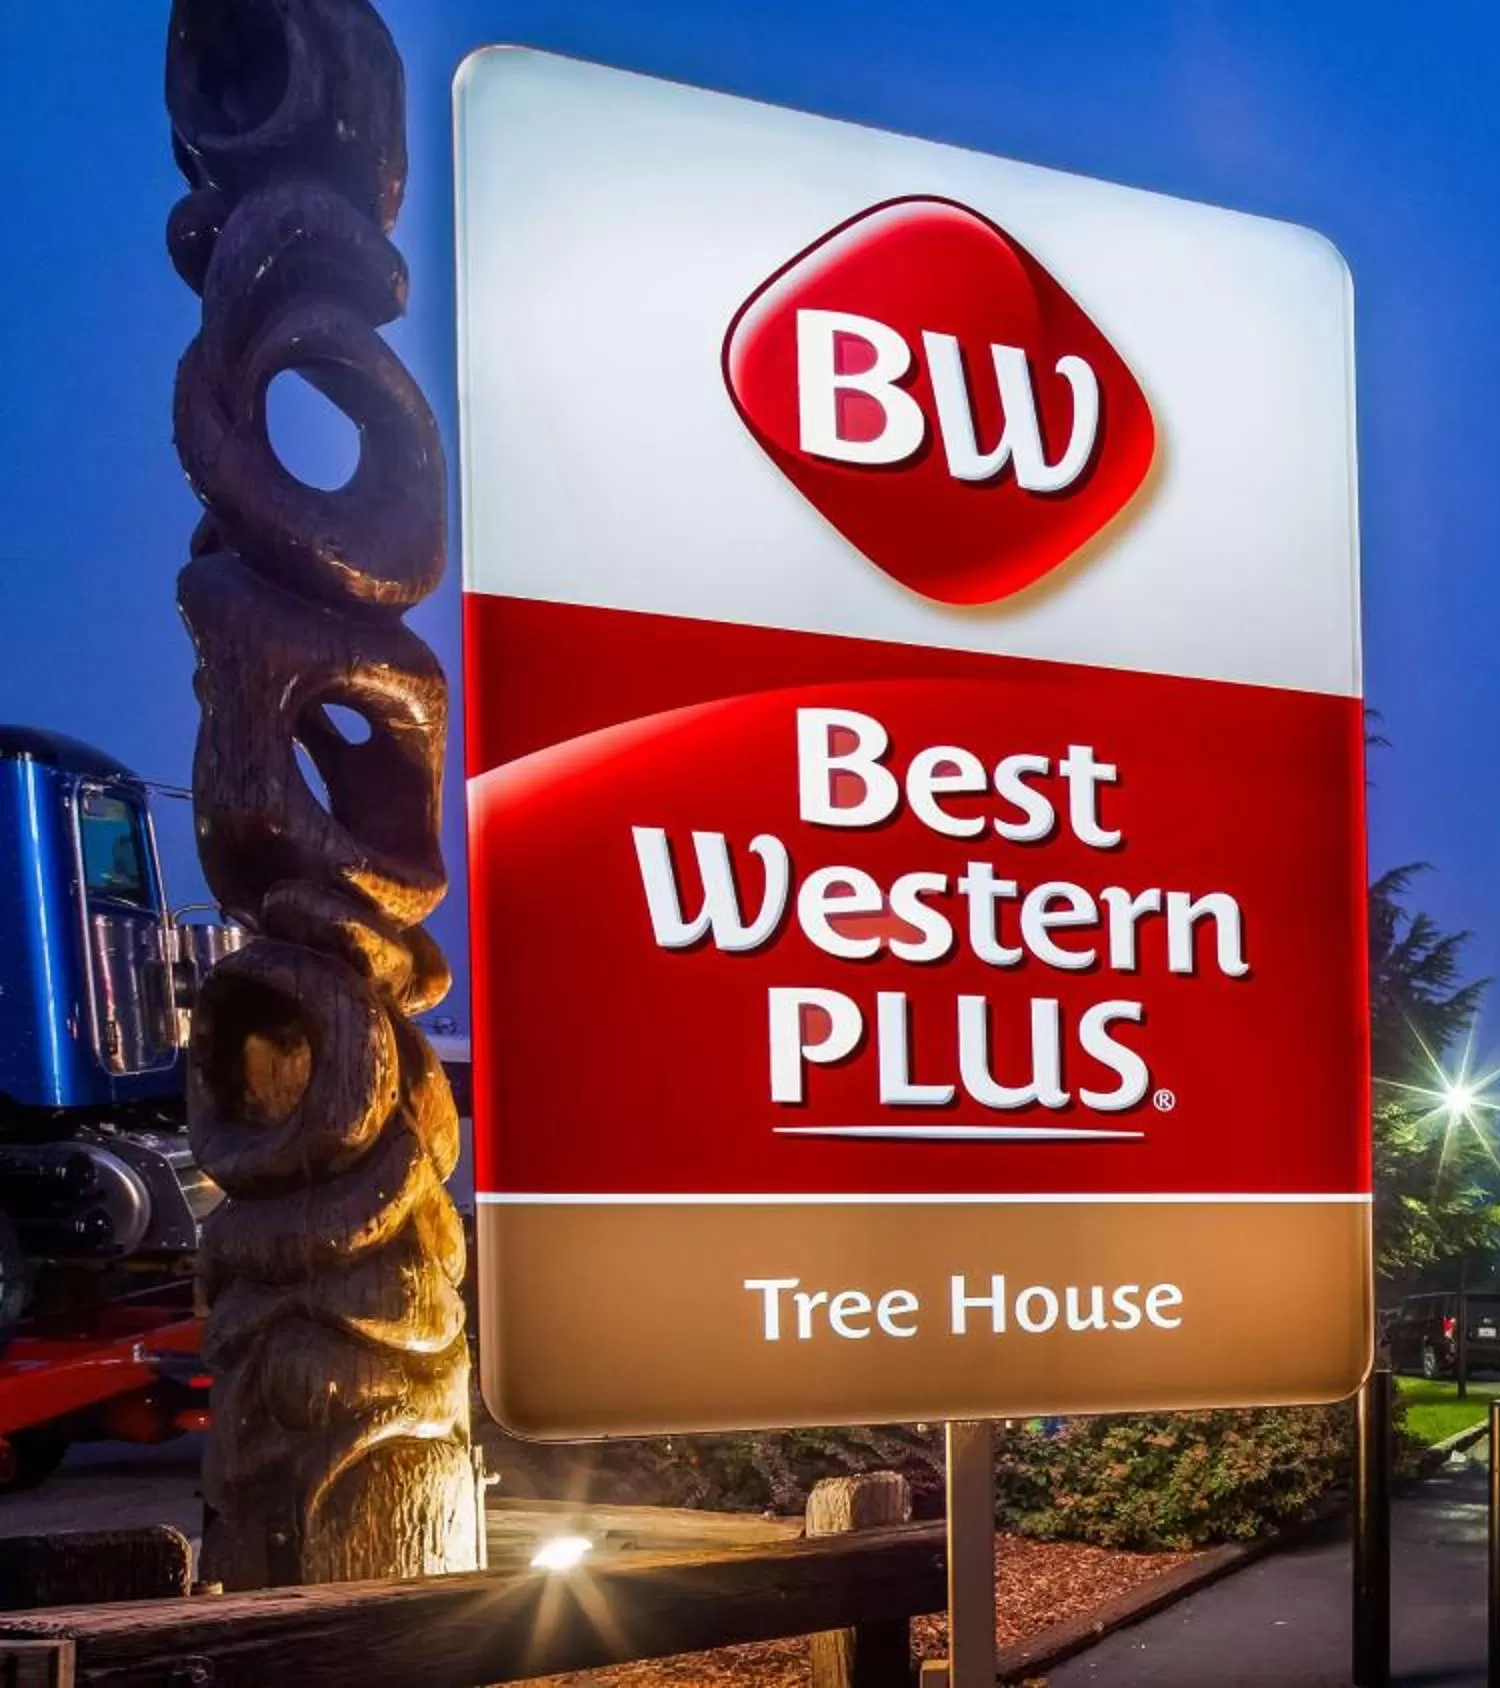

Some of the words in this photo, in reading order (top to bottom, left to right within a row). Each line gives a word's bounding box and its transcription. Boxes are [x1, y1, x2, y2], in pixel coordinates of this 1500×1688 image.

[796, 309, 1099, 492] BW
[797, 707, 1121, 847] Best
[631, 826, 1249, 976] Western
[743, 1277, 919, 1341] Tree
[951, 1274, 1184, 1335] House
